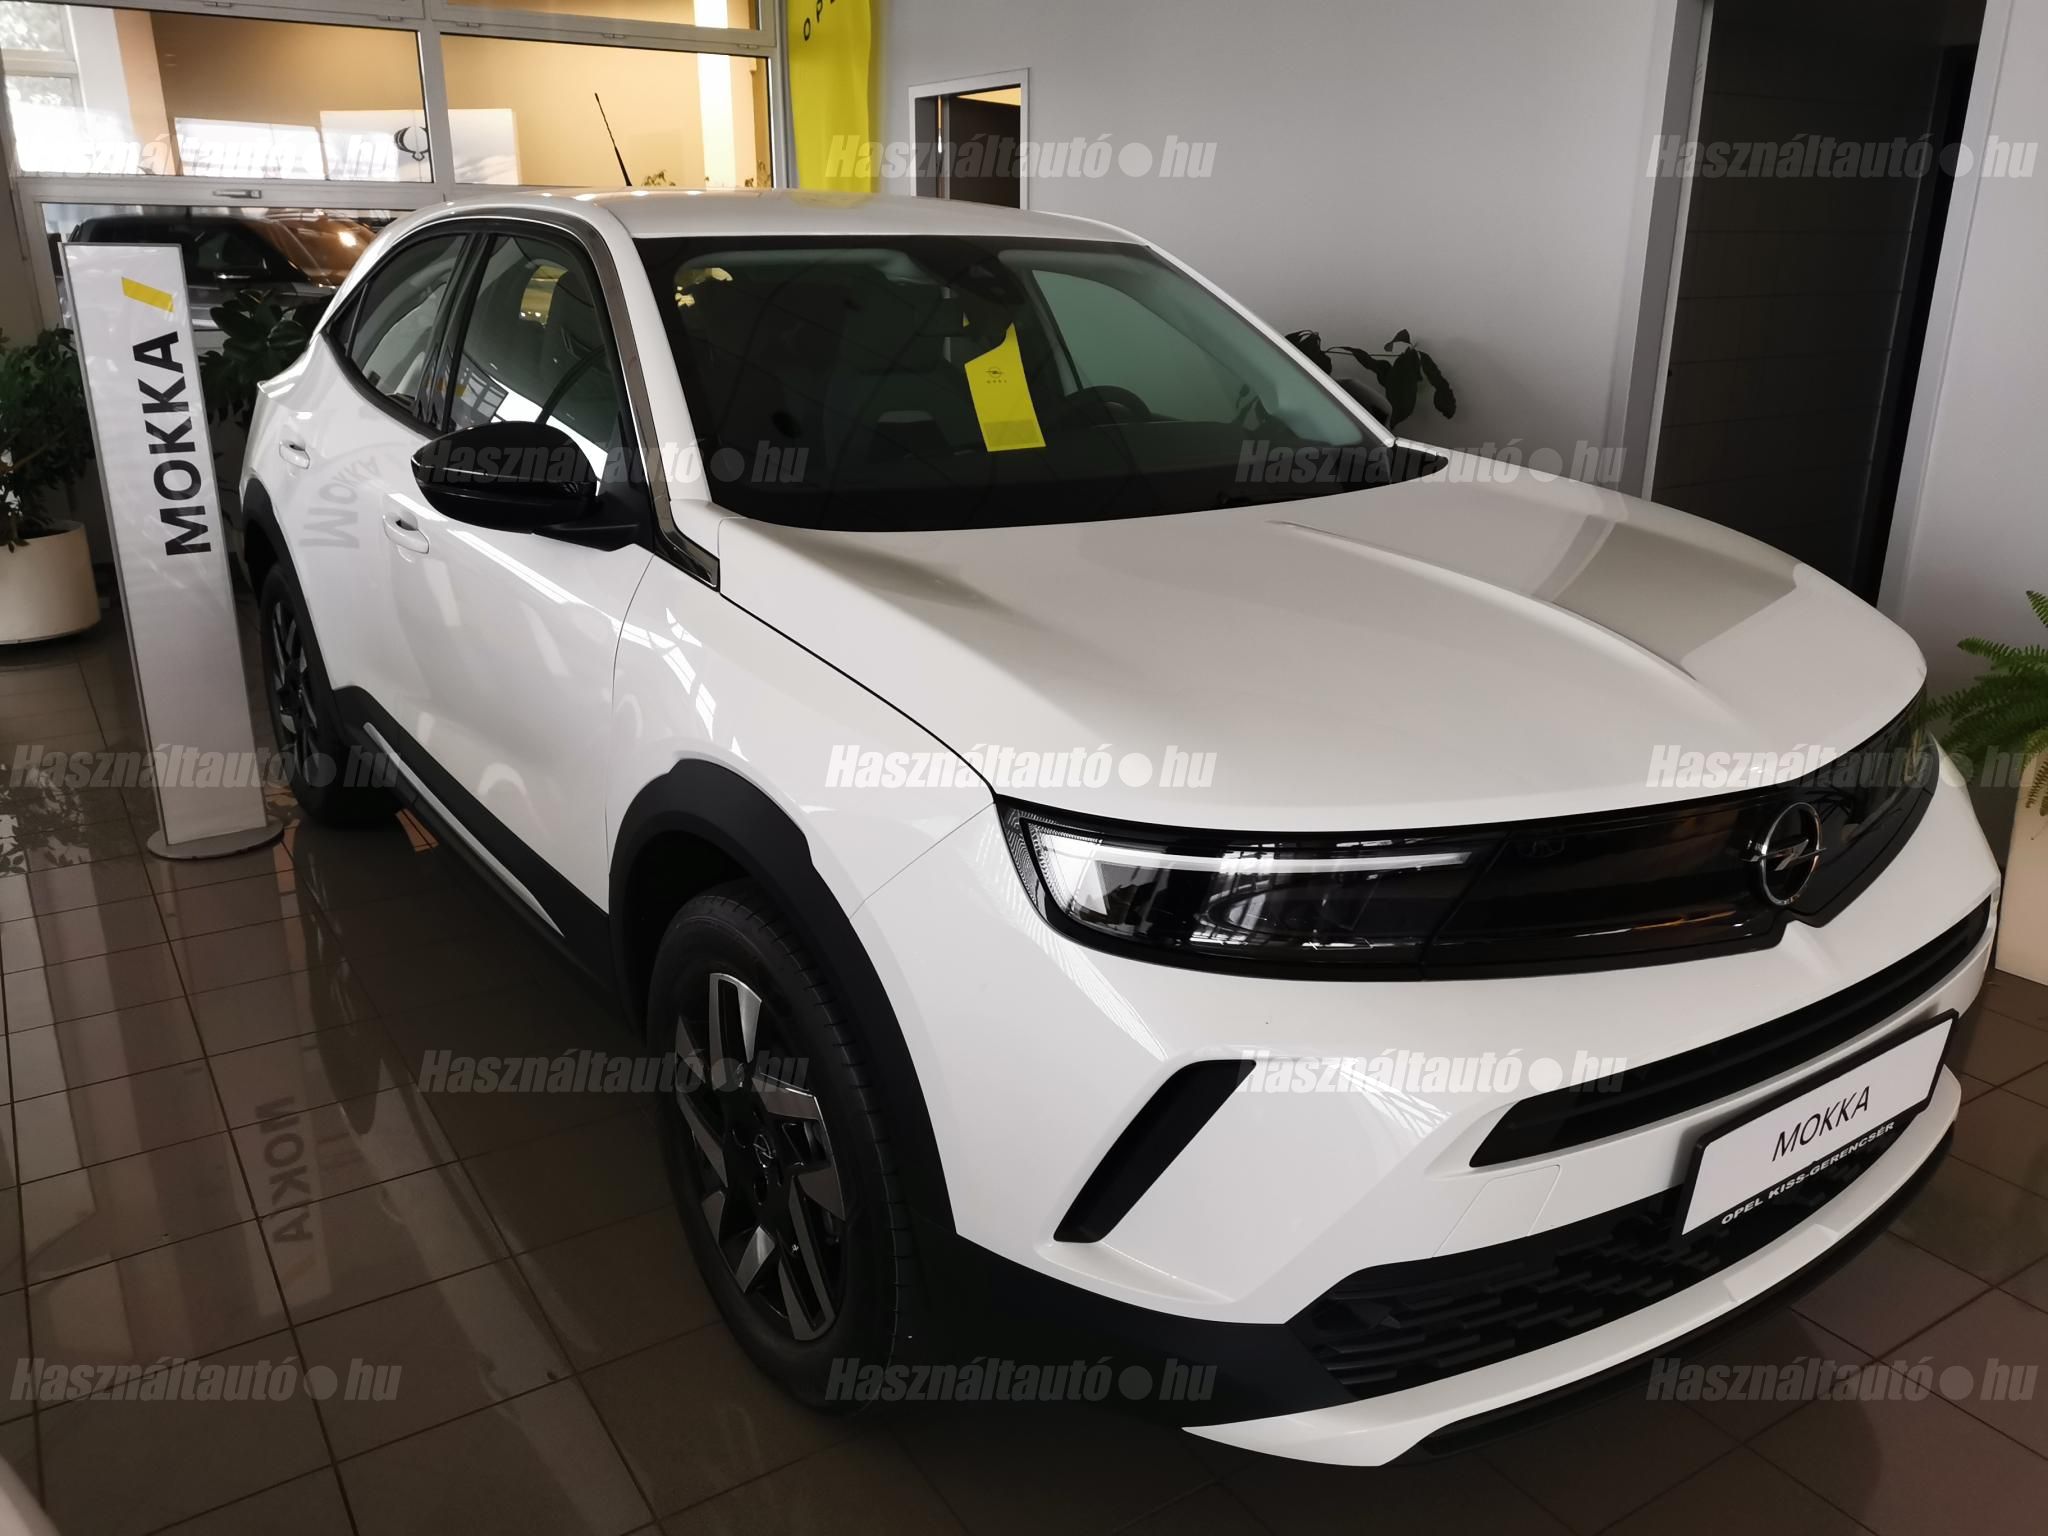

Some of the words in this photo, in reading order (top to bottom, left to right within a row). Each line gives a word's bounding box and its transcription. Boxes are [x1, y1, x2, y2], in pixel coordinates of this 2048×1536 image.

[803, 0, 835, 41] OP
[132, 331, 211, 556] MOKKA
[1771, 1086, 1871, 1162] MOKKA
[1721, 1198, 1764, 1225] OPEL
[1768, 1121, 1895, 1199] KISS-GERENCSÉR
